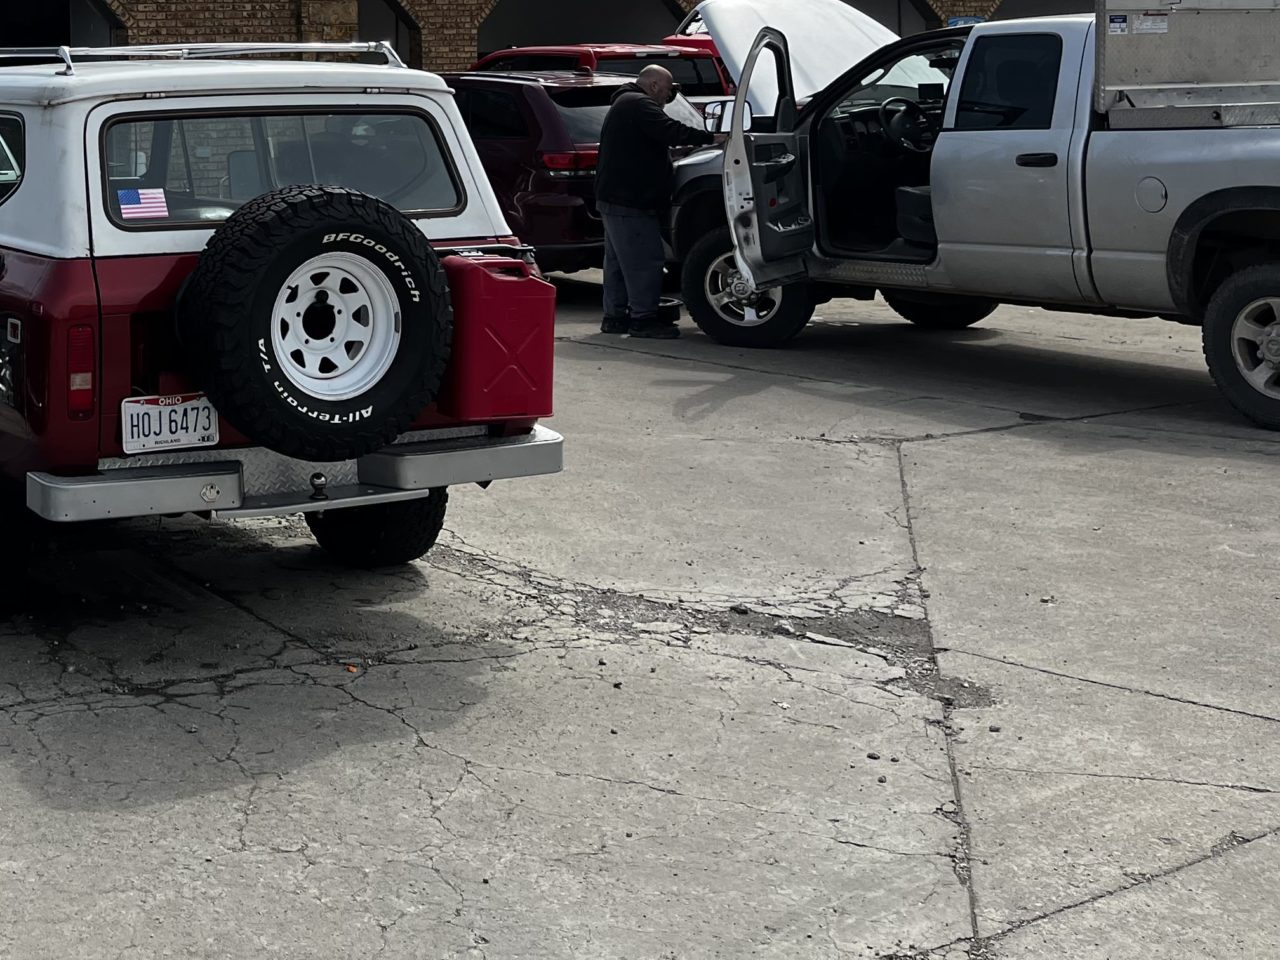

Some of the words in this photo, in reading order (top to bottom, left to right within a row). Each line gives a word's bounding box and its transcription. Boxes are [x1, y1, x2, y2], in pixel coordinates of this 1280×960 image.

[322, 232, 420, 302] BFGoodrich
[258, 338, 271, 373] T/A
[158, 396, 182, 406] OHIO
[274, 381, 373, 423] All-Terrain
[130, 410, 162, 439] HOJ
[169, 406, 211, 434] 6473
